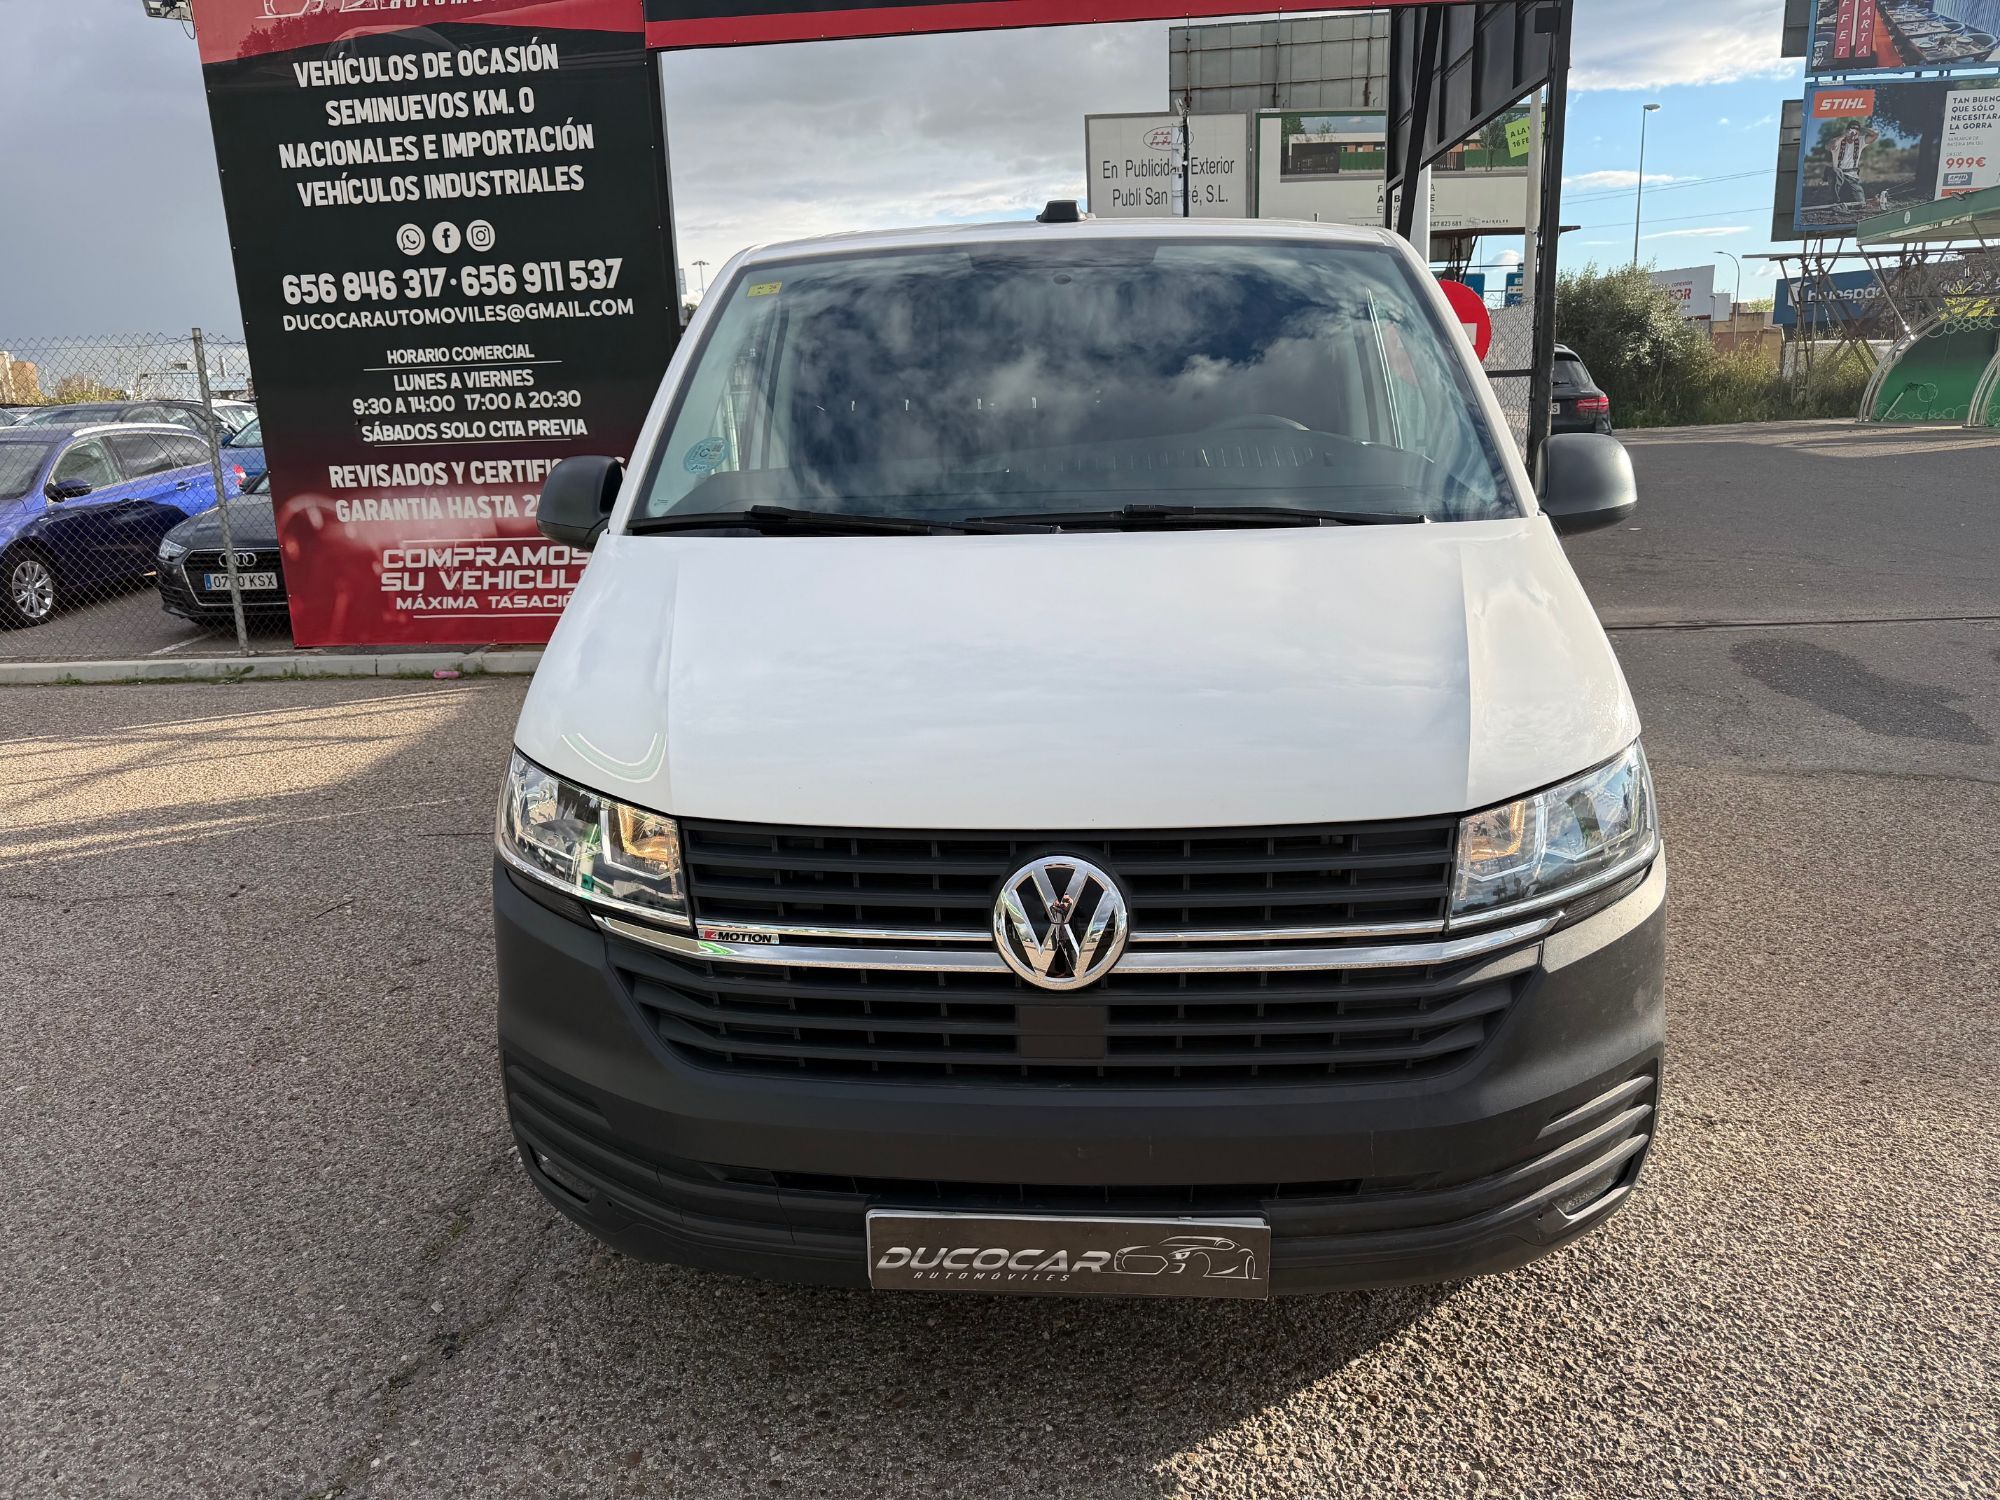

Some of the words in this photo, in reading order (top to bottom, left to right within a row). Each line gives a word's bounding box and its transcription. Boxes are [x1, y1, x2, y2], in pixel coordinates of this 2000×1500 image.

[293, 52, 418, 88] VEHÍCULOS
[422, 51, 453, 78] DE
[457, 37, 559, 77] OCASIÓN
[325, 91, 469, 126] SEMINUEVOS
[473, 89, 514, 117] KM.
[1820, 98, 1867, 110] STIHL
[1972, 103, 1995, 111] SÓLO
[1517, 127, 1527, 135] LA
[278, 135, 419, 169] NACIONALES
[423, 134, 438, 160] E
[442, 117, 594, 158] IMPORTACIÓN
[1102, 160, 1118, 179] En
[1190, 156, 1235, 175] Exterior
[1946, 156, 1986, 169] 999€
[296, 172, 420, 207] VEHÍCULOS
[424, 164, 585, 199] INDUSTRIALES
[1112, 187, 1141, 207] Publi
[1145, 186, 1168, 205] San
[1206, 184, 1228, 203] S.L.
[282, 272, 338, 305] 656
[342, 269, 397, 302] 846
[522, 261, 563, 294] 911
[569, 257, 623, 290] 537
[283, 298, 634, 332] DUCOCARAUTOMOVILES@GMAIL.COM
[386, 347, 450, 365] HORARIO
[451, 343, 535, 362] COMERCIAL
[393, 373, 447, 391] LUNES
[450, 372, 463, 389] A
[464, 369, 535, 388] VIERNES
[352, 397, 392, 416] 9:30
[395, 396, 407, 414] A
[408, 394, 456, 413] 14:00
[464, 392, 512, 411] 17:00
[514, 392, 527, 409] A
[528, 389, 582, 409] 20:30
[361, 421, 439, 443] SÁBADOS
[441, 420, 487, 439] SOLO
[489, 420, 526, 438] CITA
[528, 418, 589, 436] PREVIA
[328, 461, 450, 489] REVISADOS
[451, 461, 466, 485] Y
[335, 495, 446, 523] GARANTIA
[447, 495, 517, 520] HASTA
[382, 545, 593, 569] COMPRAMOS
[213, 576, 245, 588] 070
[249, 575, 275, 587] KSX
[380, 572, 425, 592] SU
[439, 569, 587, 592] VEHICUL
[396, 593, 479, 610] MÁXIMA
[876, 1246, 1111, 1273] DUCOCAR
[913, 1271, 1071, 1283] AUTOMÓVILES
